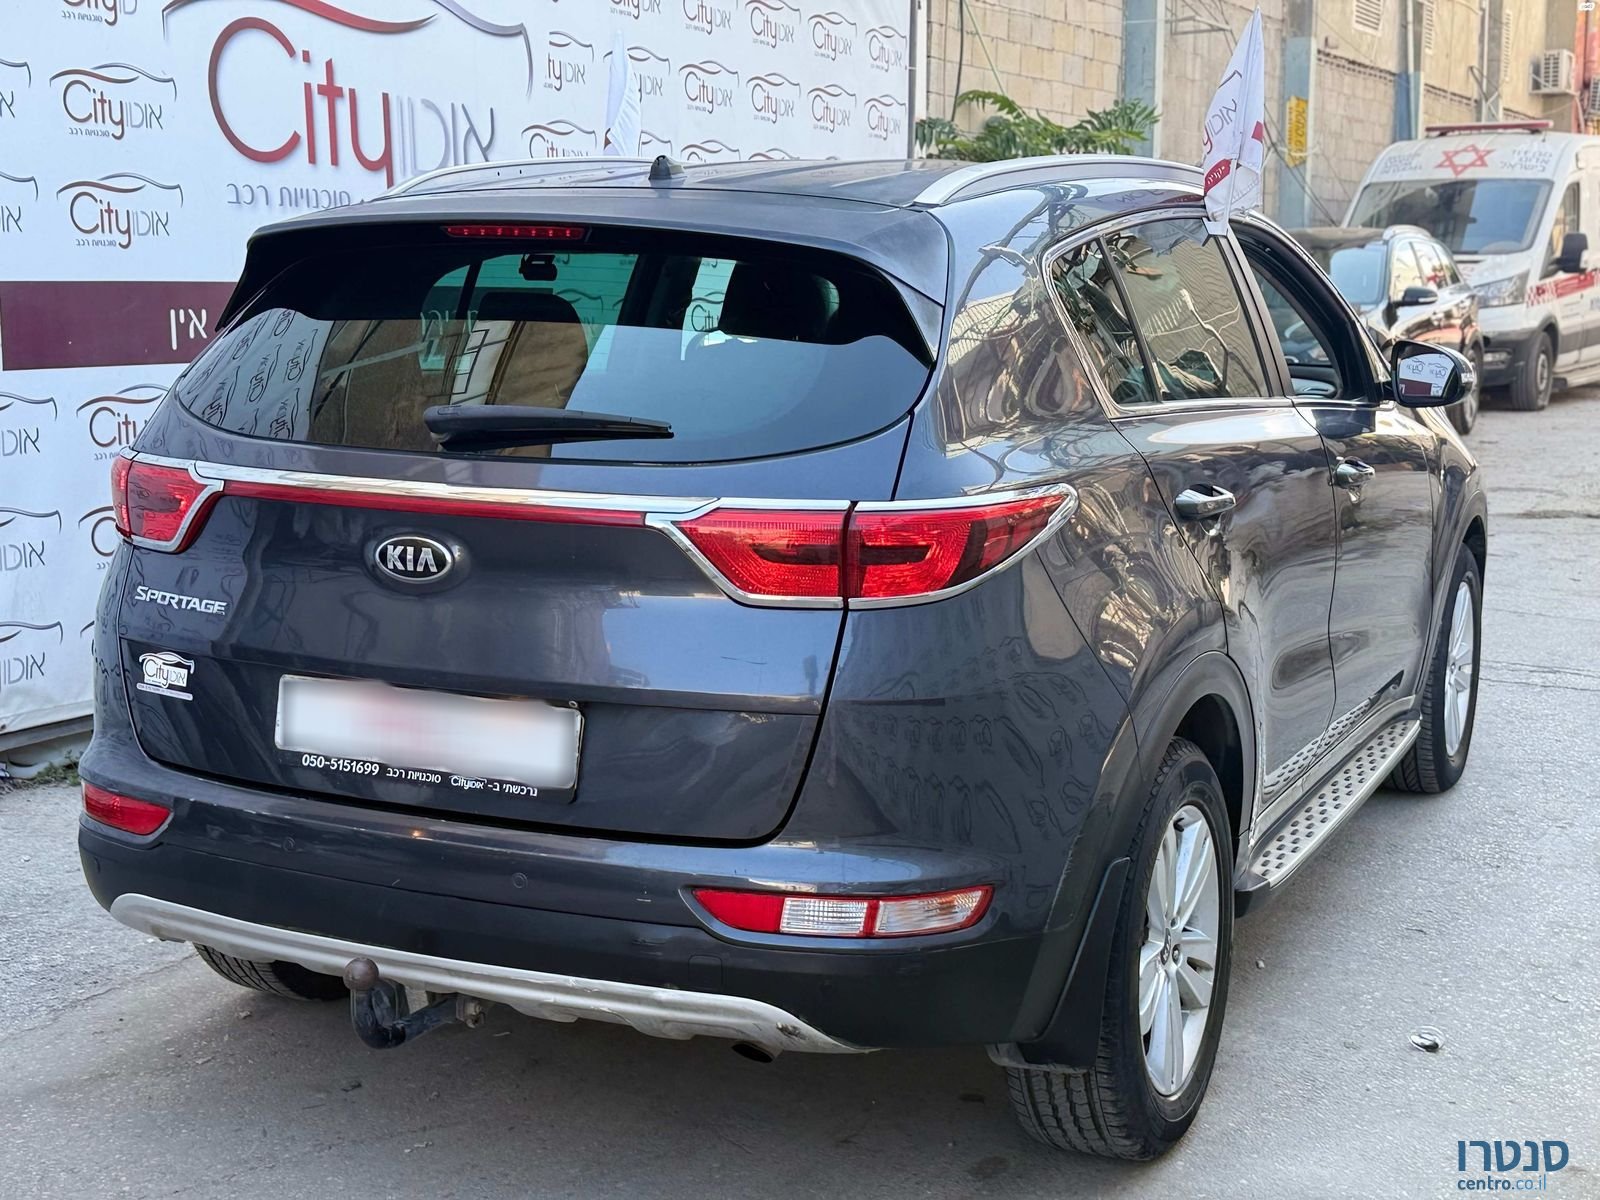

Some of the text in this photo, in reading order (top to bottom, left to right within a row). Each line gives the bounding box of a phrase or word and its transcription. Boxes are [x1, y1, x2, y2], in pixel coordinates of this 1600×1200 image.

[63, 79, 125, 140] City
[226, 182, 270, 206] רכב
[70, 191, 132, 250] City
[169, 308, 208, 351] אין
[386, 544, 438, 573] KIA
[134, 584, 228, 616] SPORTAGE
[301, 753, 380, 777] 050-5151699
[385, 766, 406, 779] רכב
[502, 783, 538, 797] נרכשתי
